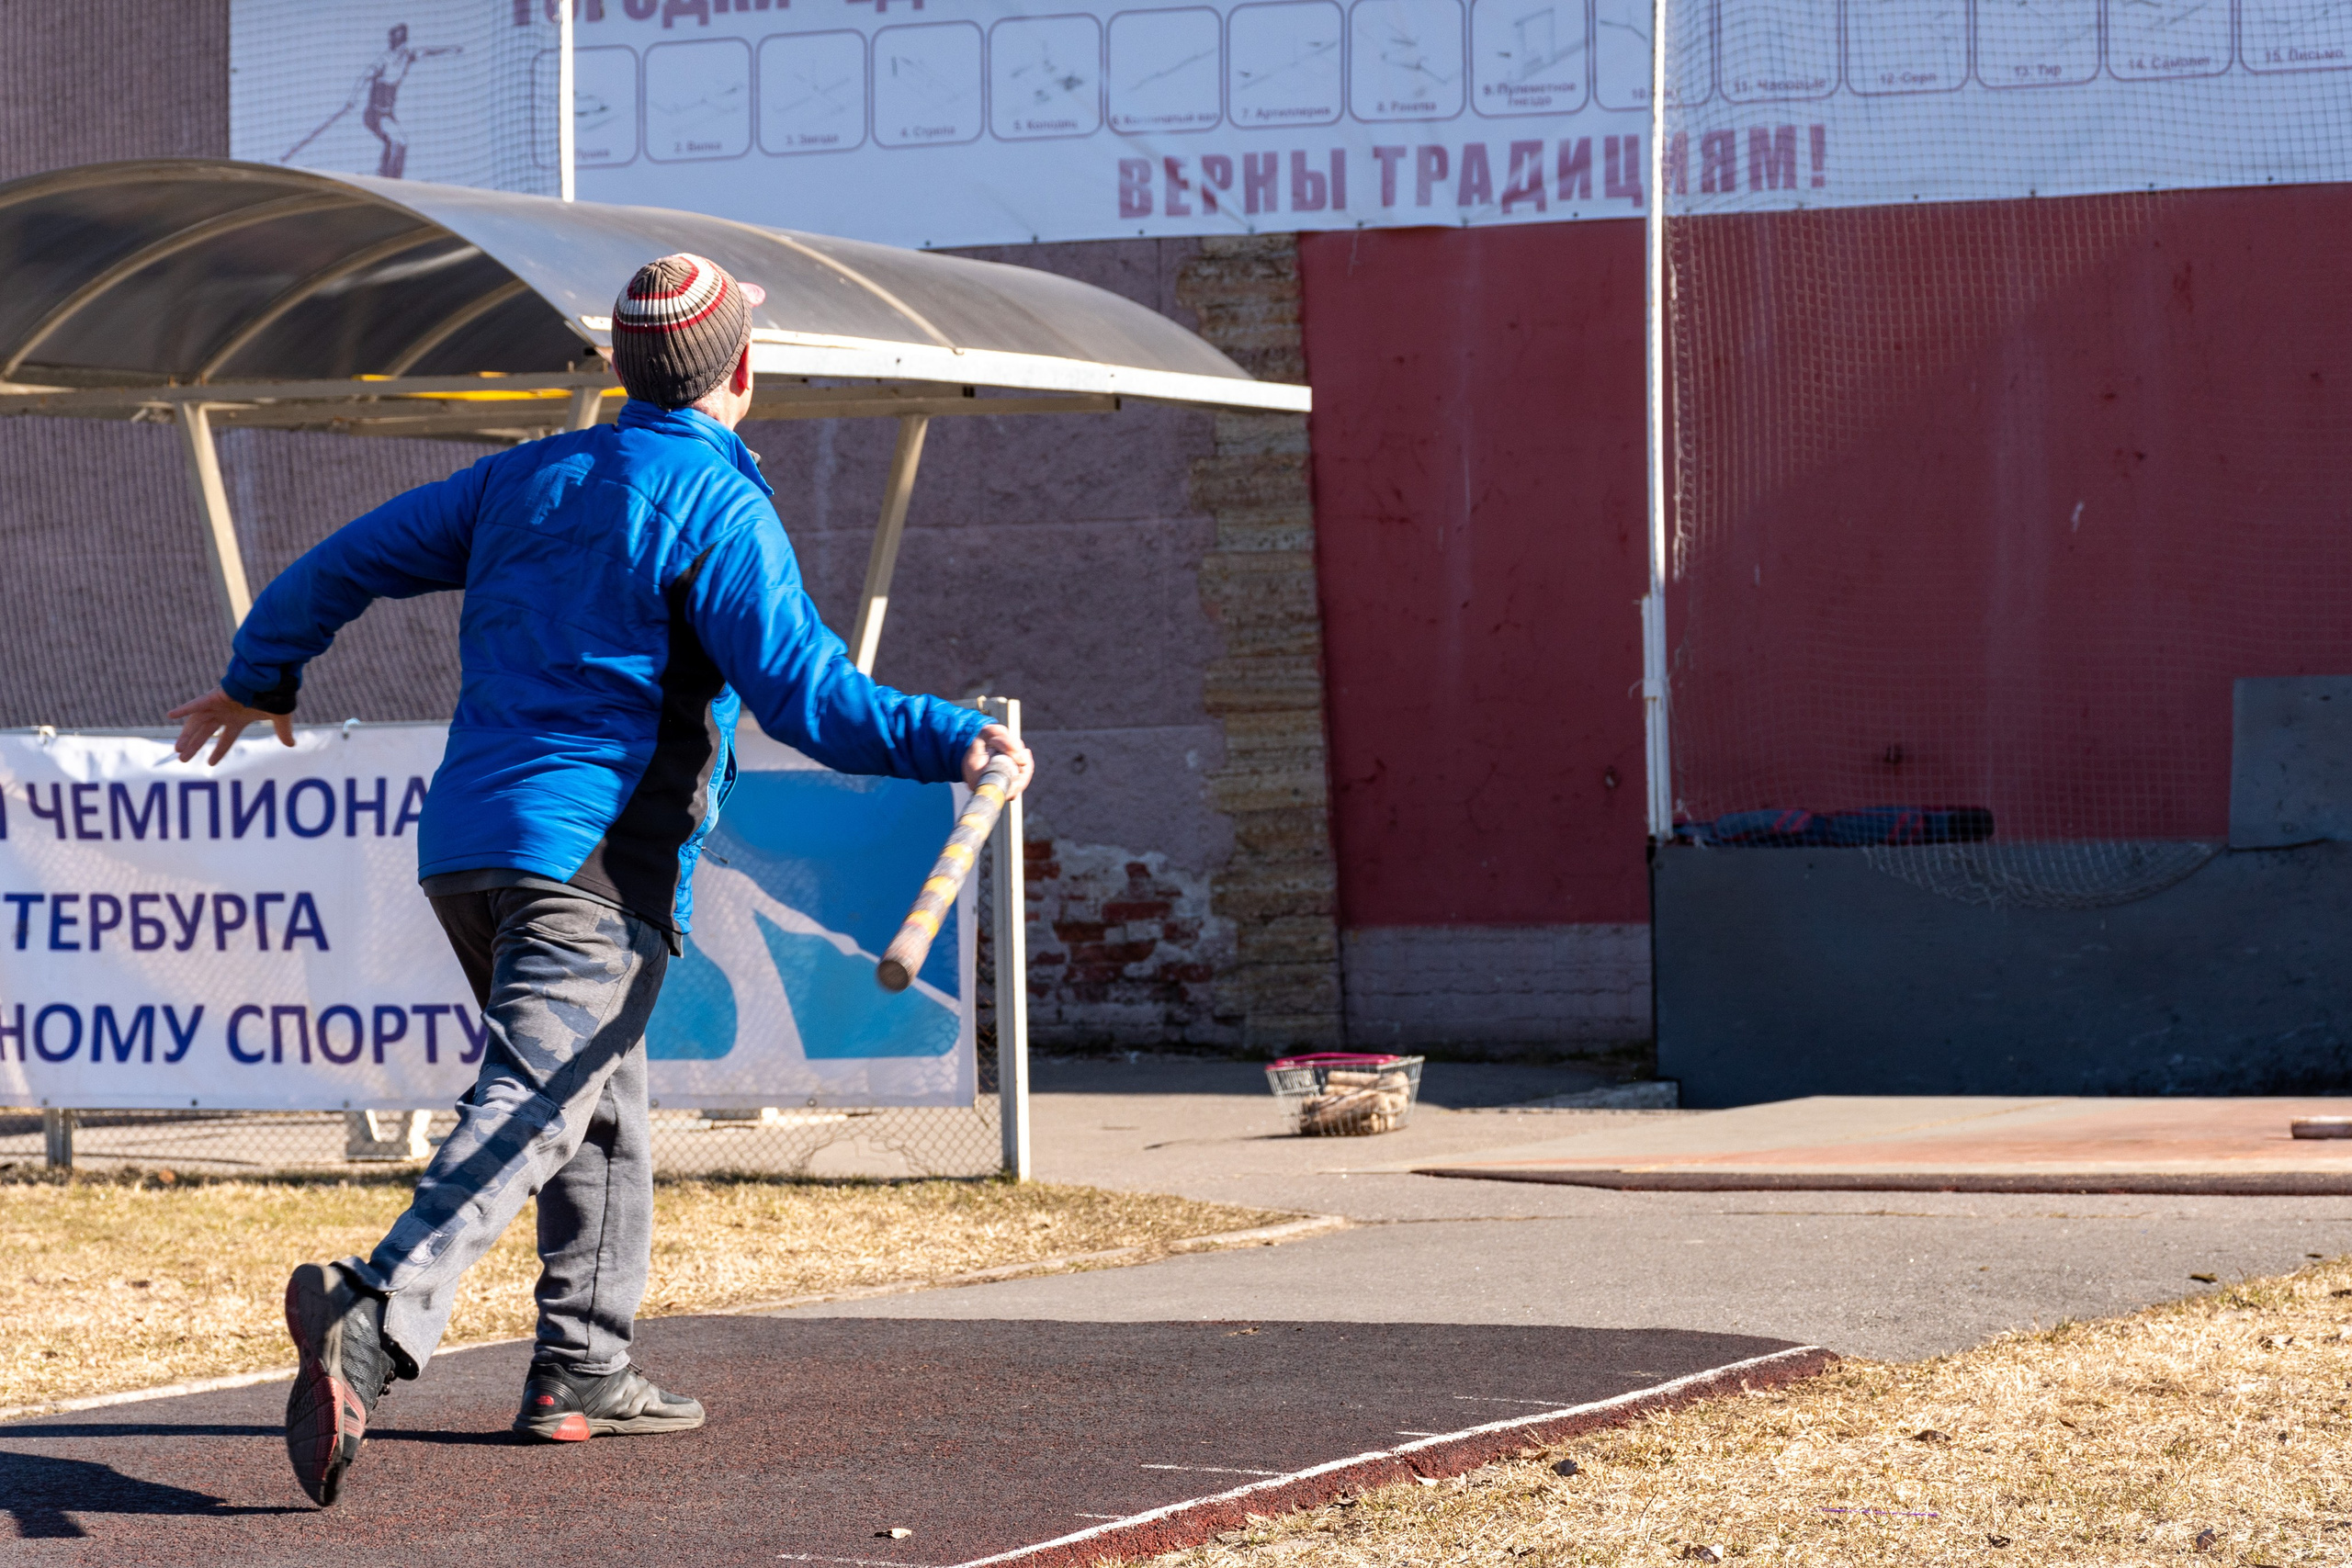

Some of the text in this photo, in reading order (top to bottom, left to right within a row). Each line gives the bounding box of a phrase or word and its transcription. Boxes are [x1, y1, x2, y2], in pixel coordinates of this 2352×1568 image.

[1901, 71, 1937, 85] Серп
[2037, 64, 2062, 76] Тир
[1118, 125, 1826, 219] ВЕРНЫ ТРАДИЦИЯМ!
[226, 1003, 489, 1064] СПОРТУ
